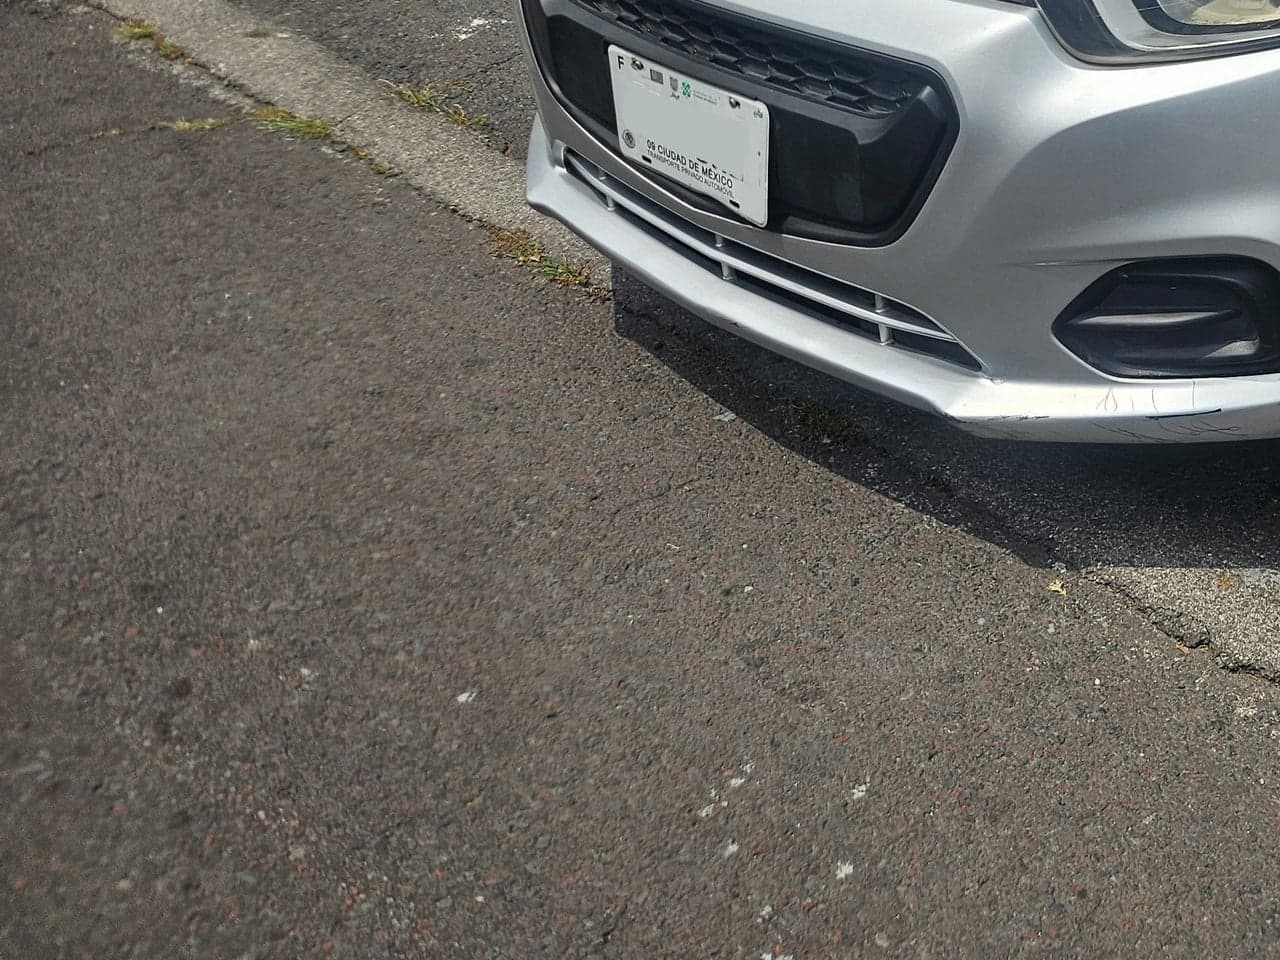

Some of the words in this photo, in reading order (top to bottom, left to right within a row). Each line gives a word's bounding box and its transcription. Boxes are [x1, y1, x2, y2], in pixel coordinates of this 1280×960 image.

[617, 56, 624, 69] F
[657, 144, 687, 166] CIUDAD
[688, 158, 700, 172] DE
[701, 165, 733, 189] MÉXICO
